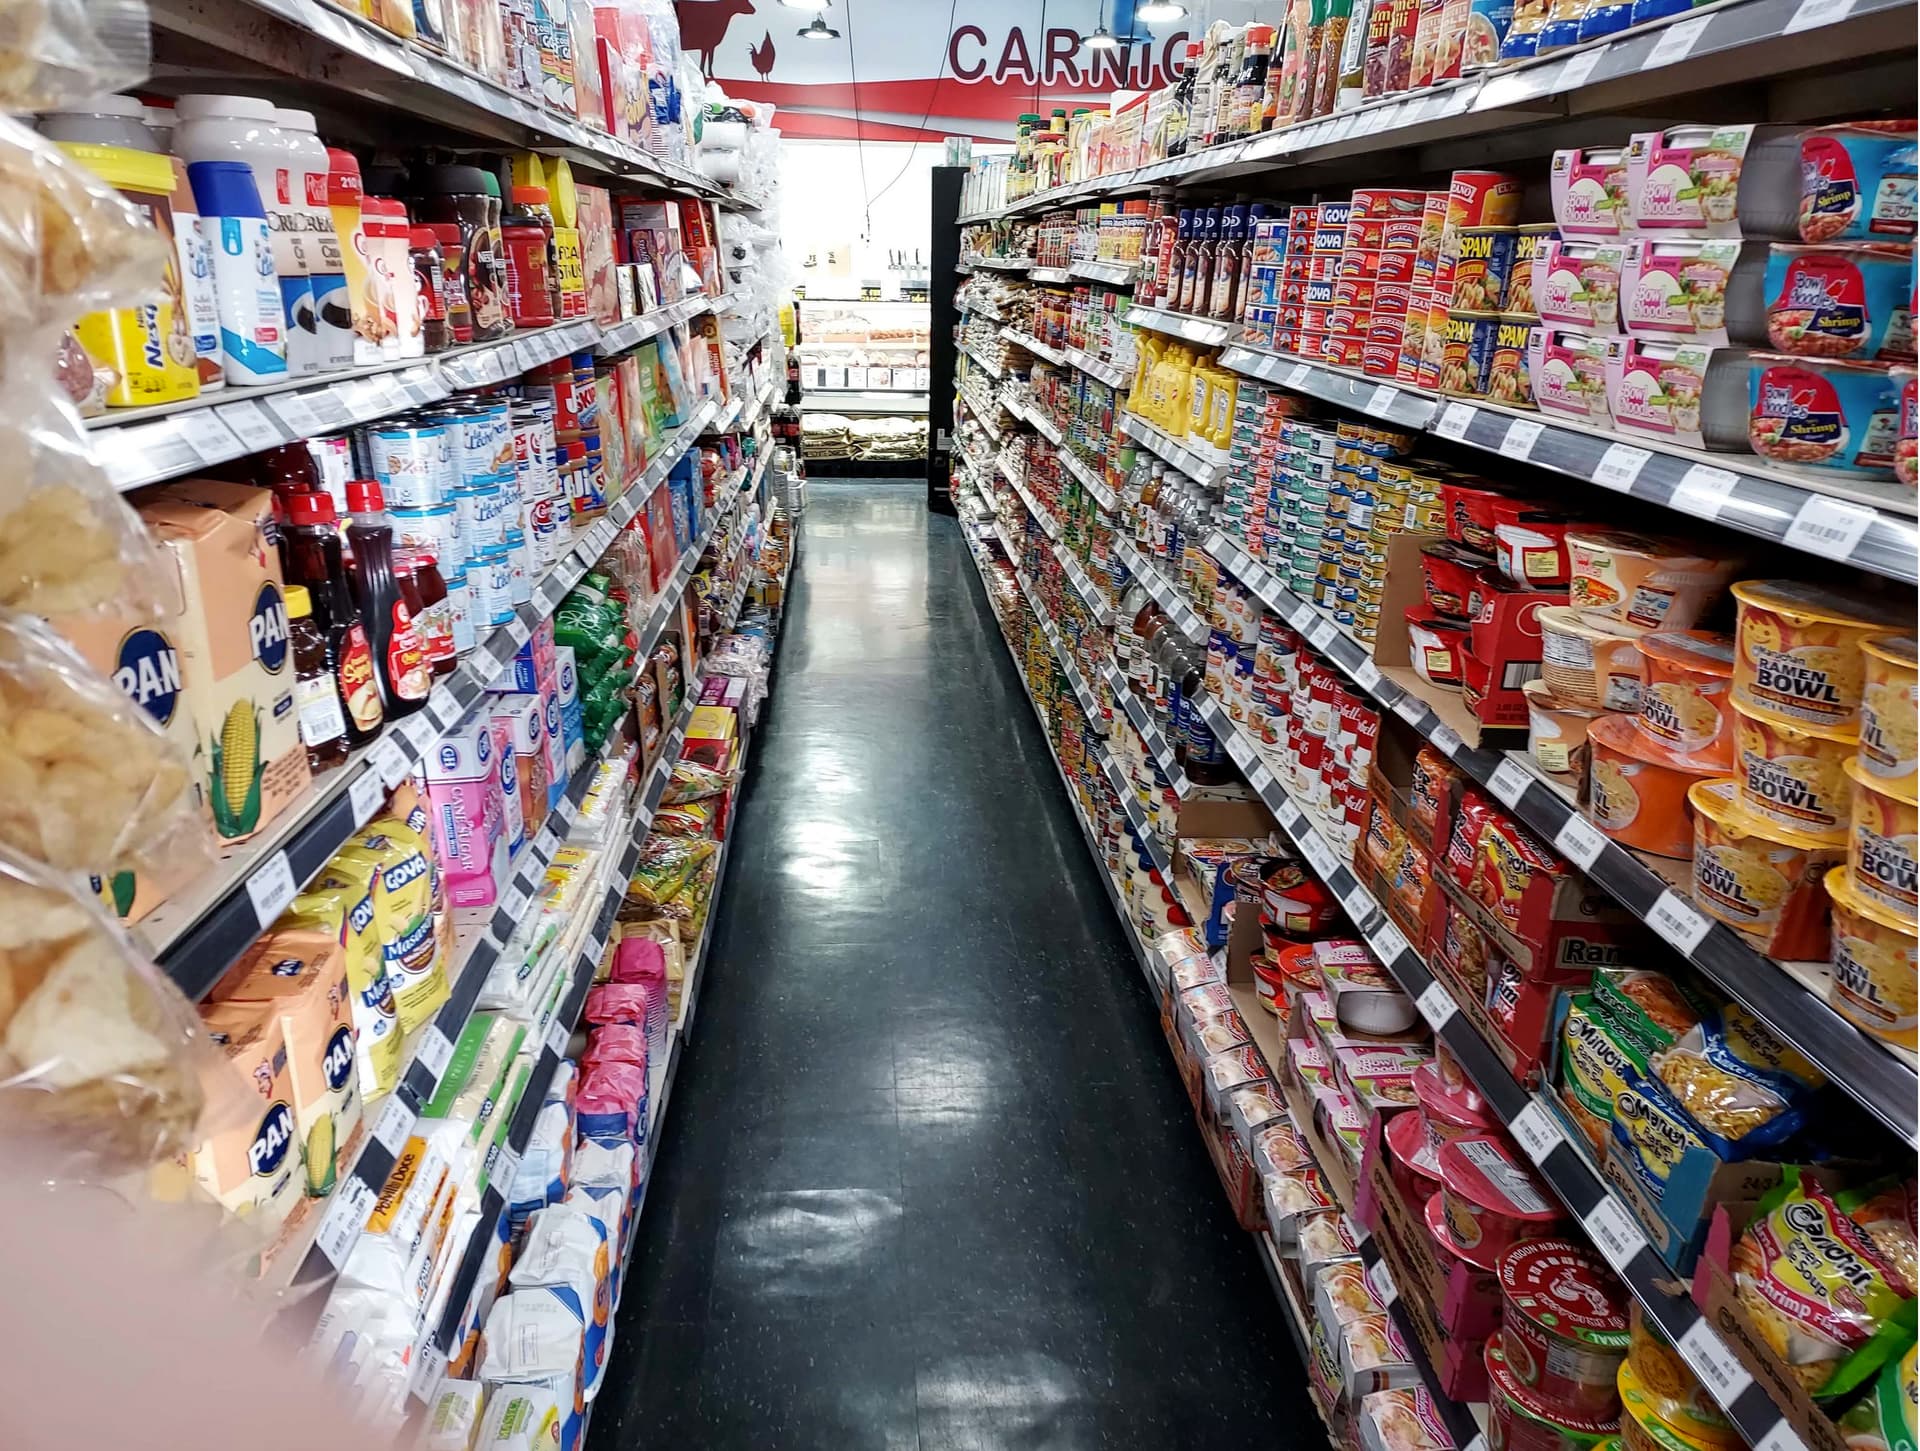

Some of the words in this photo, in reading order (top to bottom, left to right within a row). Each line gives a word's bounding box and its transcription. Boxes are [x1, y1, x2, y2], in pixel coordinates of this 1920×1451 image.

[950, 25, 1189, 88] CARNIC
[1817, 189, 1852, 207] Shrimp
[1325, 209, 1348, 222] GOY
[1460, 236, 1493, 257] SPAM
[1516, 236, 1540, 258] SPA
[1795, 271, 1826, 293] Bowl
[1447, 319, 1475, 343] SPAM
[1496, 324, 1529, 348] SPAM
[1817, 315, 1861, 328] Shrimp
[1765, 383, 1793, 402] Bowl
[1790, 422, 1837, 435] Shrimp
[249, 603, 291, 660] PAN
[113, 648, 182, 705] PAN
[1759, 658, 1827, 684] RAMEN
[1758, 669, 1840, 703] BOWL
[1644, 706, 1685, 732] OWL
[1749, 763, 1808, 792] RAMEN
[454, 786, 465, 827] CANE
[1748, 774, 1823, 812] BOWL
[408, 809, 427, 834] OYA
[459, 827, 474, 872] SUGAR
[386, 855, 426, 889] GOYA
[1702, 869, 1747, 902] OWL
[1863, 852, 1918, 894] BOW
[351, 900, 374, 932] GOY
[1503, 962, 1523, 986] op
[1836, 963, 1883, 1004] OWL
[322, 1031, 354, 1087] PAN
[248, 1106, 295, 1174] PAN
[391, 1153, 415, 1182] Doce
[1608, 1162, 1638, 1207] Sauce
[1795, 1261, 1828, 1298] Soup
[1547, 1412, 1594, 1431] RAMEN
